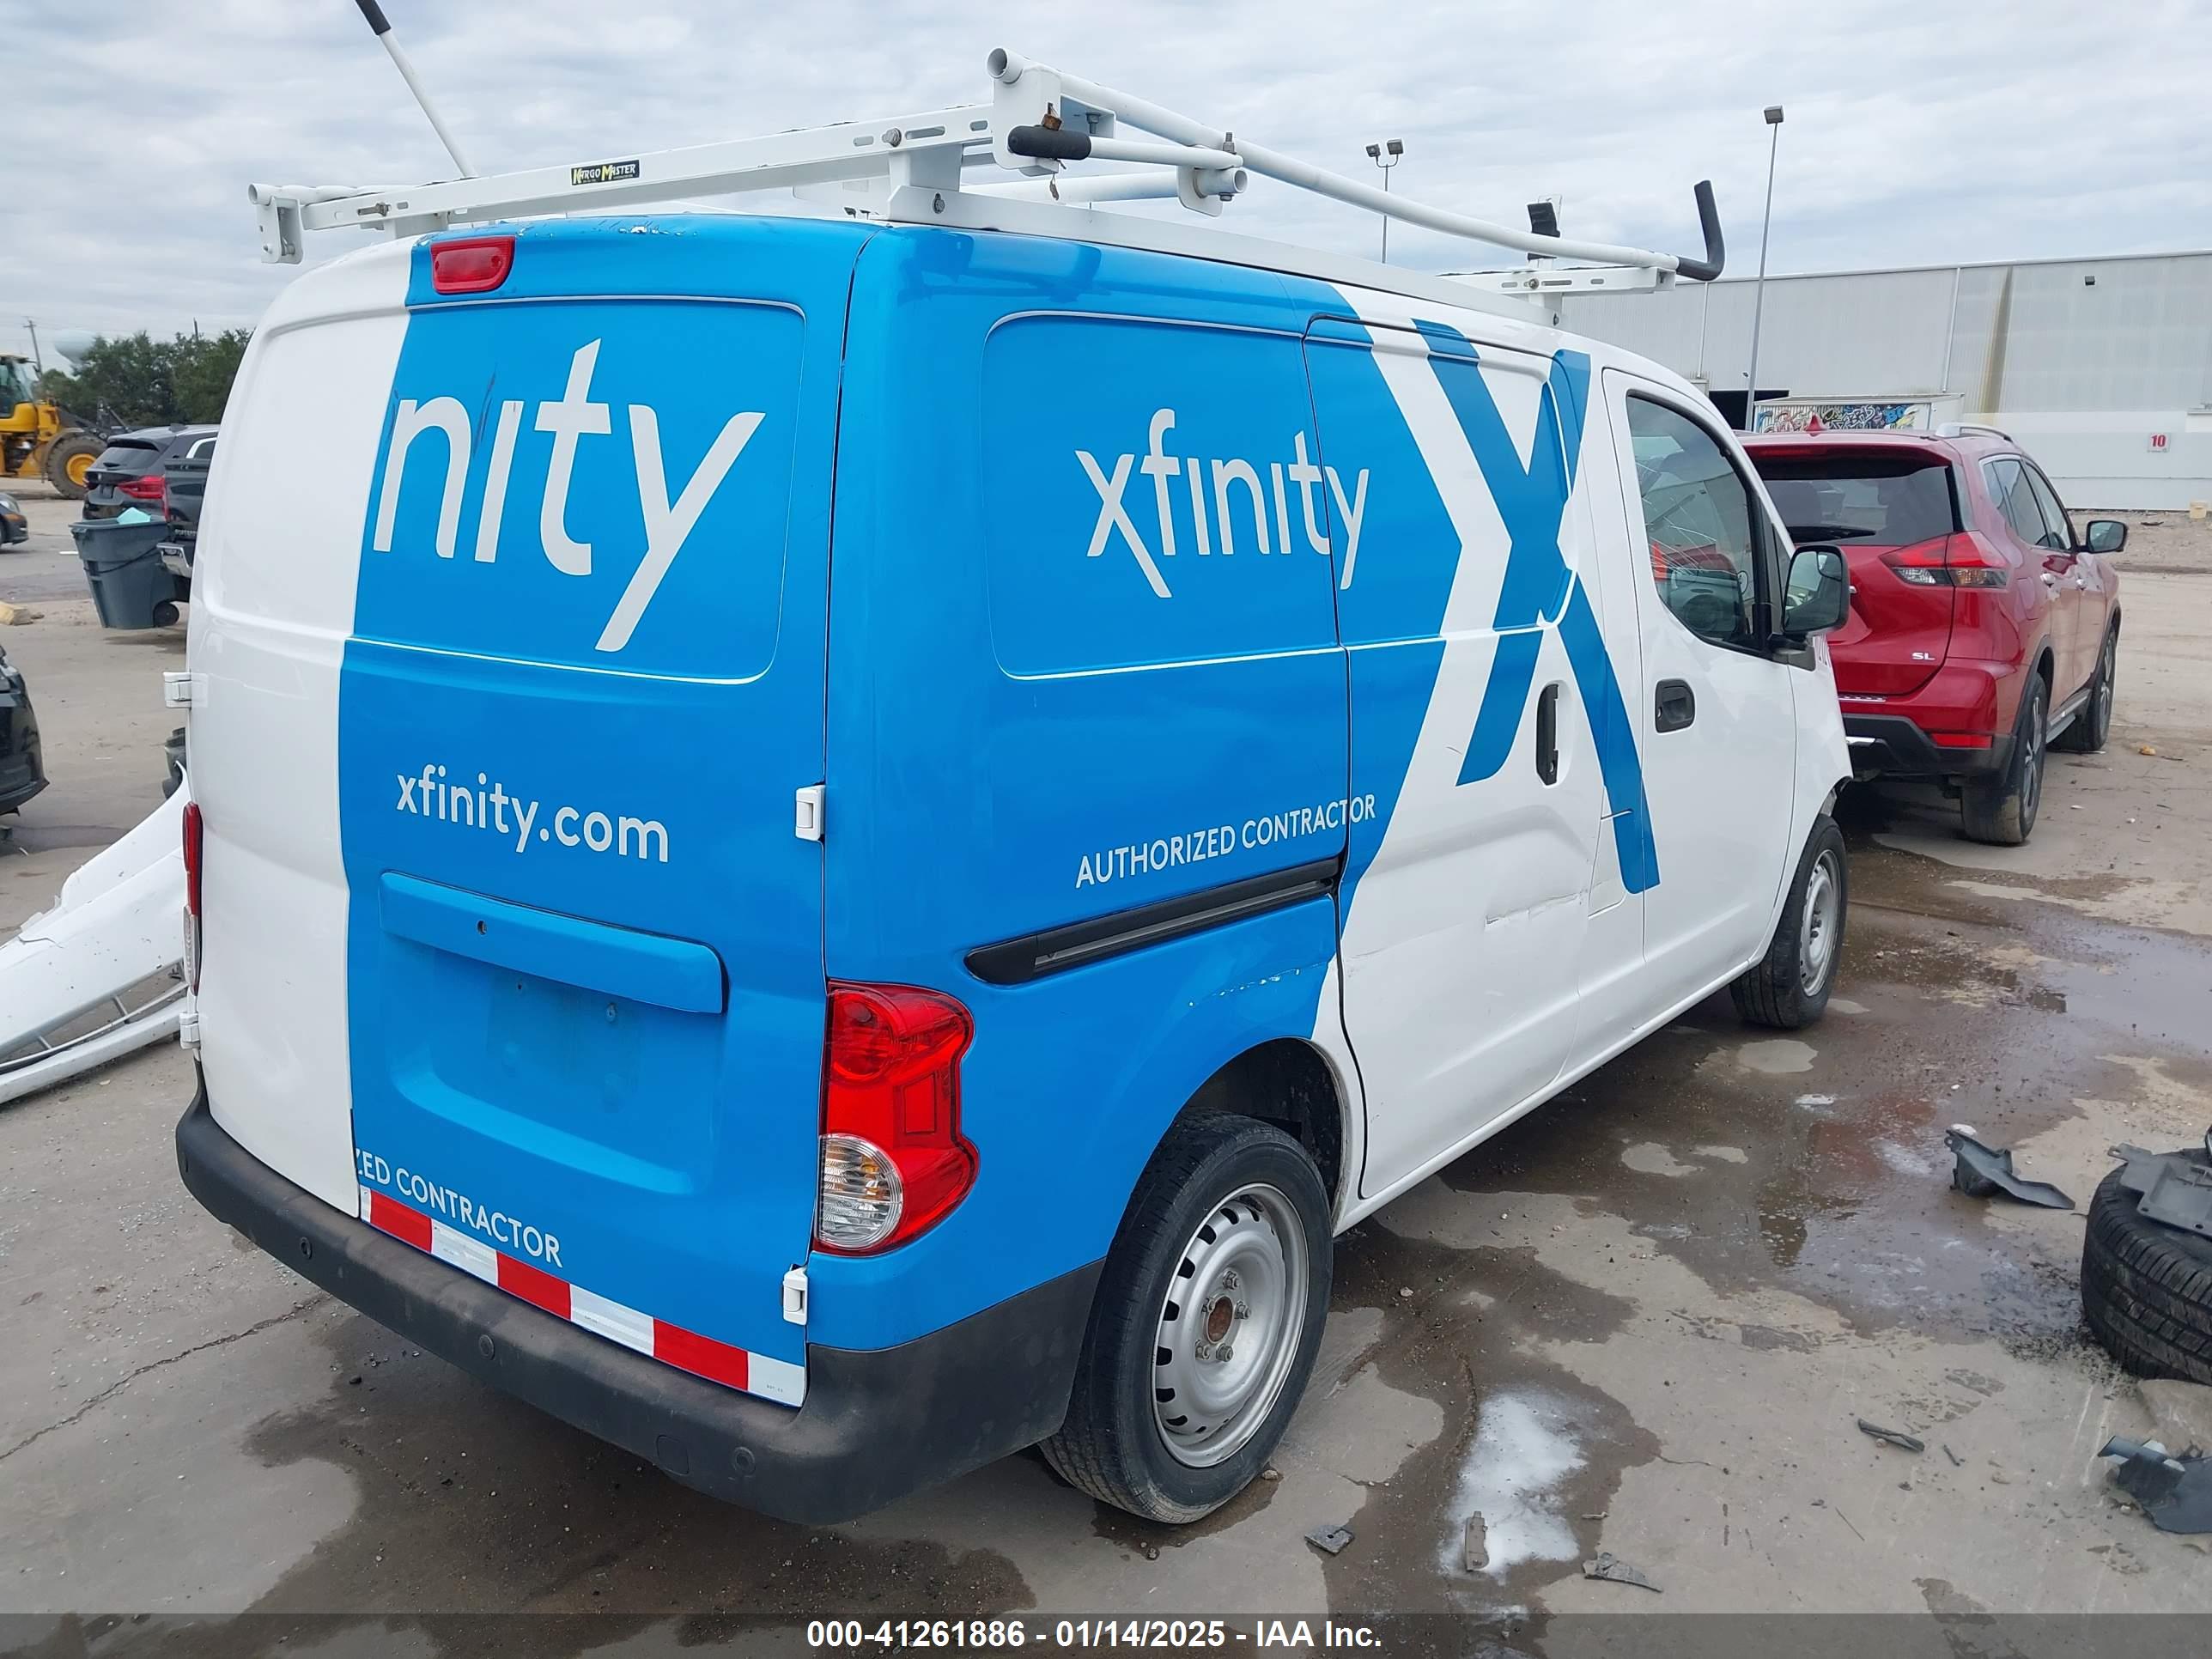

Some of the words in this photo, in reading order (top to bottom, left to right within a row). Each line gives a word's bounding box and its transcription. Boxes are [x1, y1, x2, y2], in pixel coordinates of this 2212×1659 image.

[573, 168, 601, 184] KARGO
[601, 164, 635, 180] MASTER
[2151, 434, 2166, 447] 10
[1075, 408, 1370, 599] xfinity
[1911, 652, 1936, 660] SL
[397, 764, 668, 863] xfinity.com
[1075, 824, 1236, 889] AUTHORIZED
[1242, 794, 1376, 849] CONTRACTOR
[396, 1168, 563, 1268] CONTRACTOR
